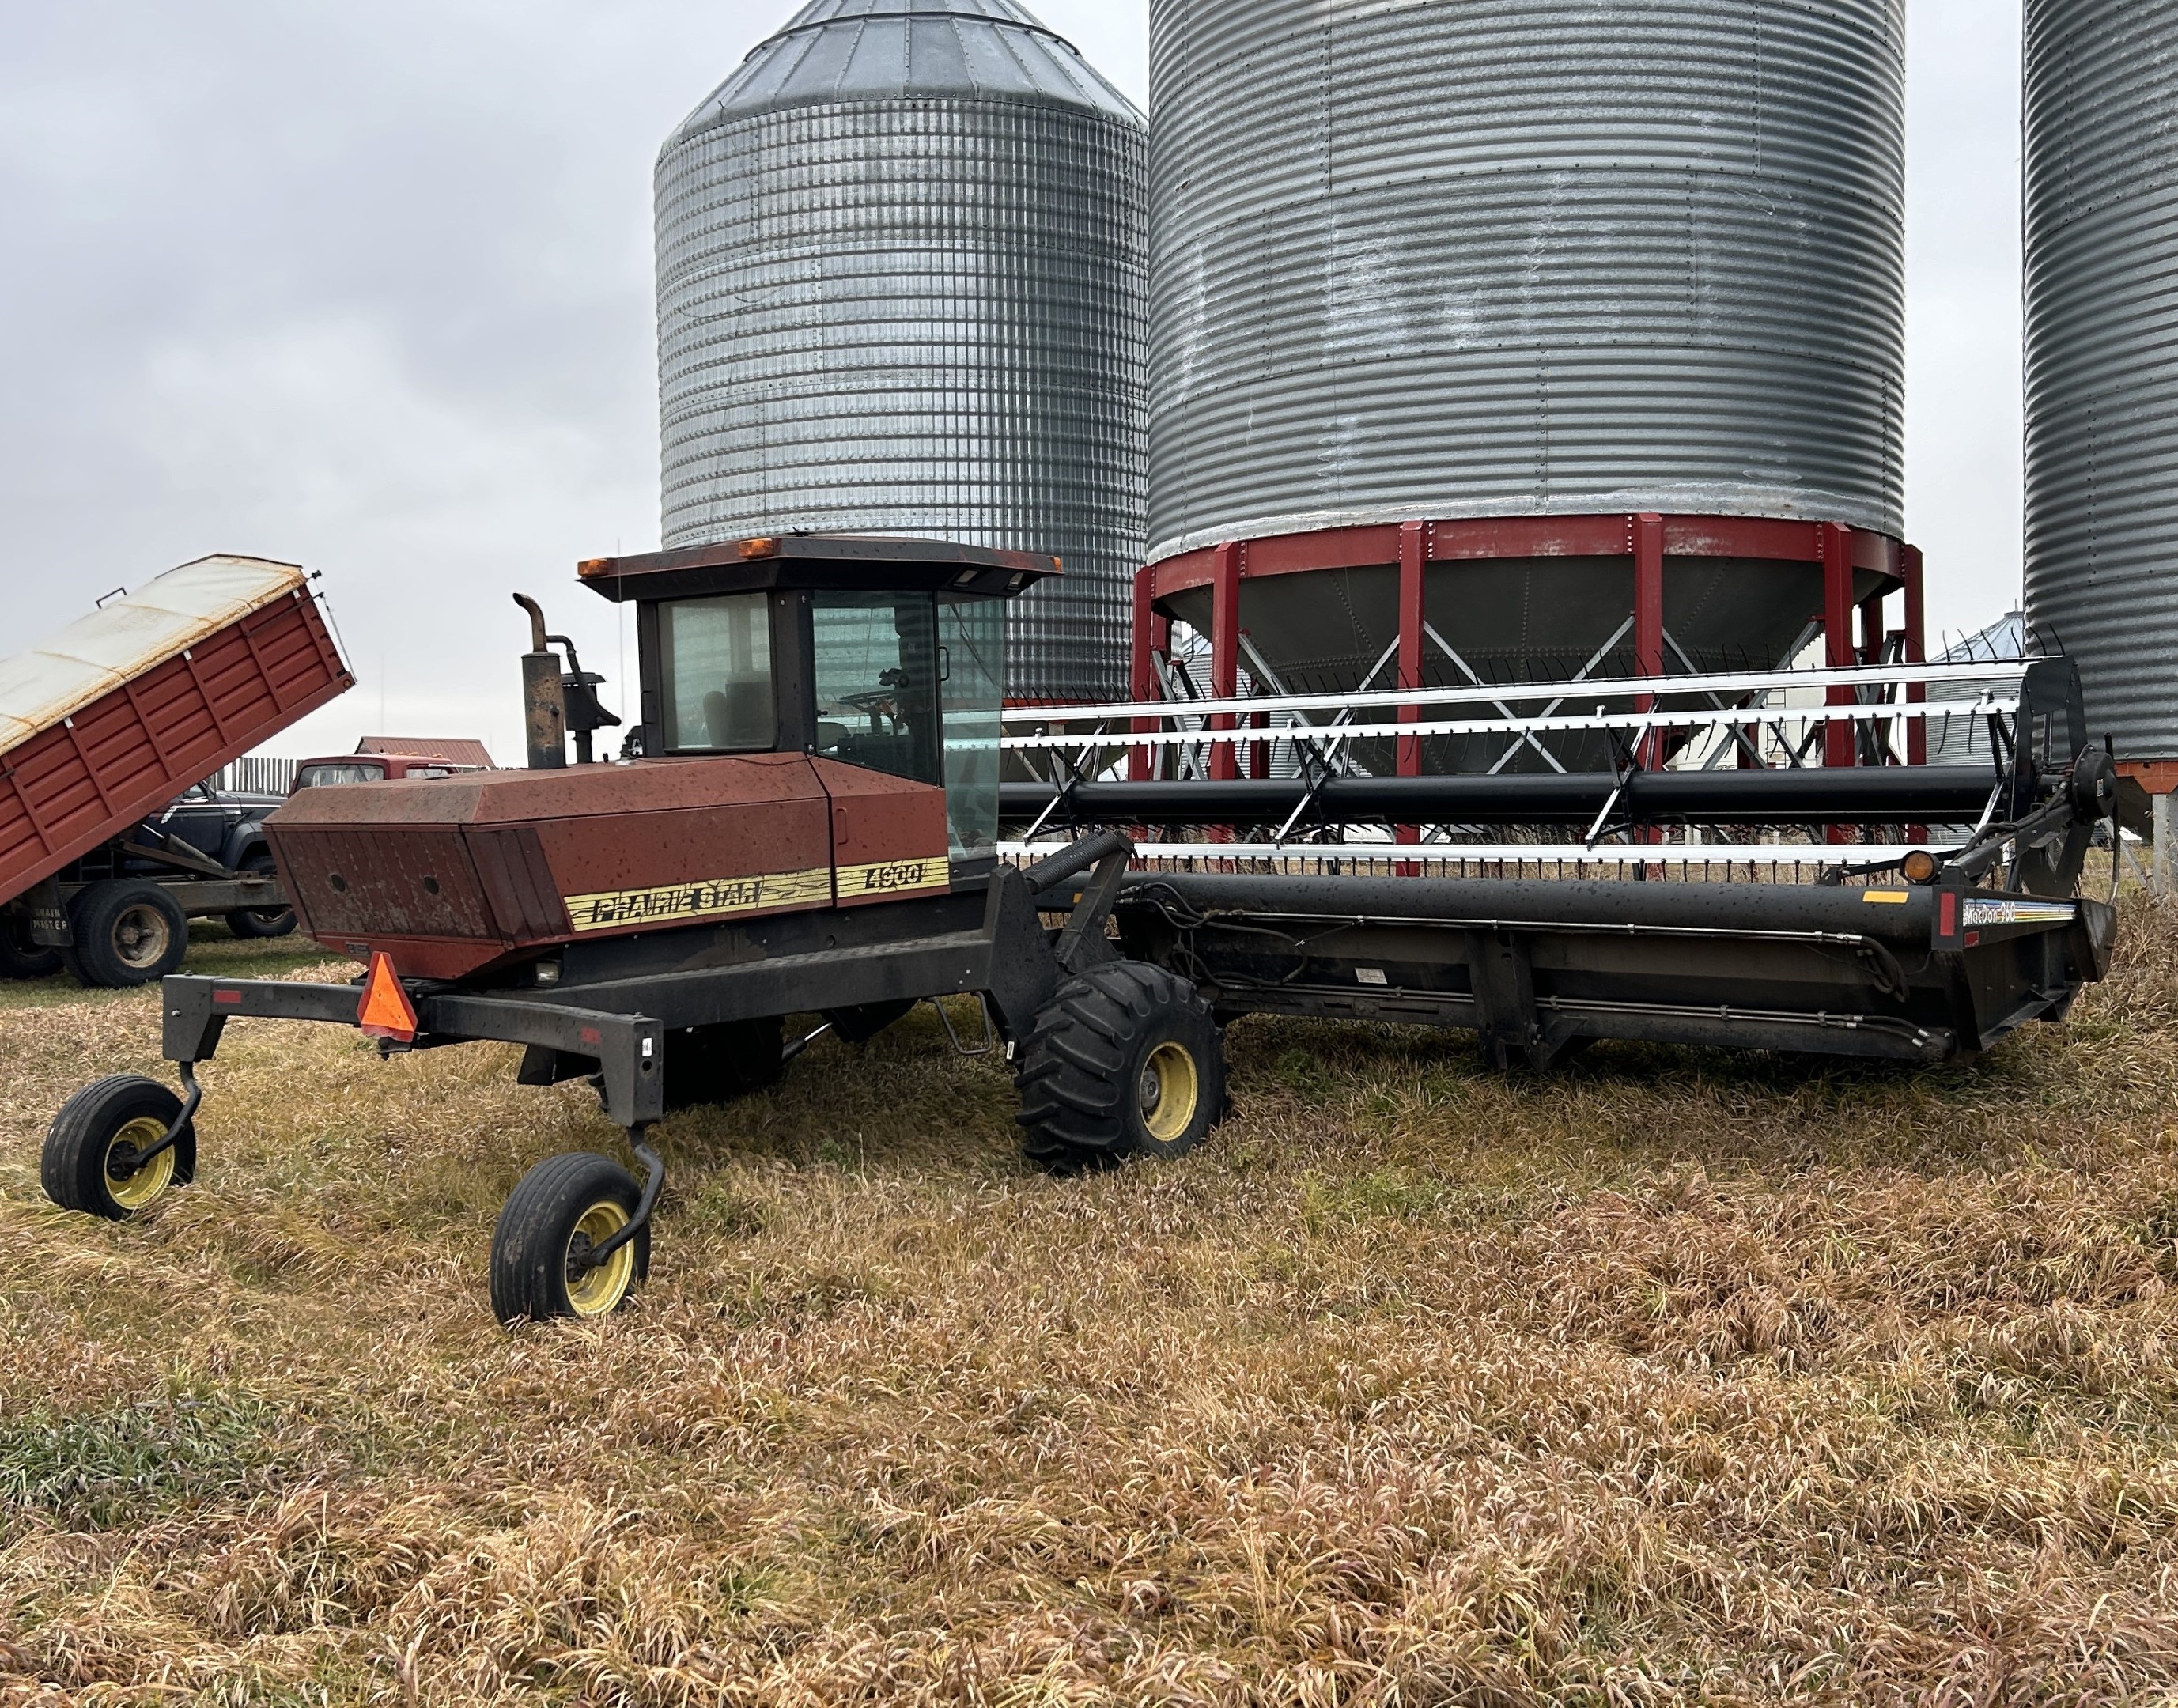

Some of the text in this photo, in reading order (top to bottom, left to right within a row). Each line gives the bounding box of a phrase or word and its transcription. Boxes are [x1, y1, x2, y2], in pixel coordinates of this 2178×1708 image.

[868, 864, 920, 887] 4900
[596, 882, 758, 923] PRAIRIE STAR
